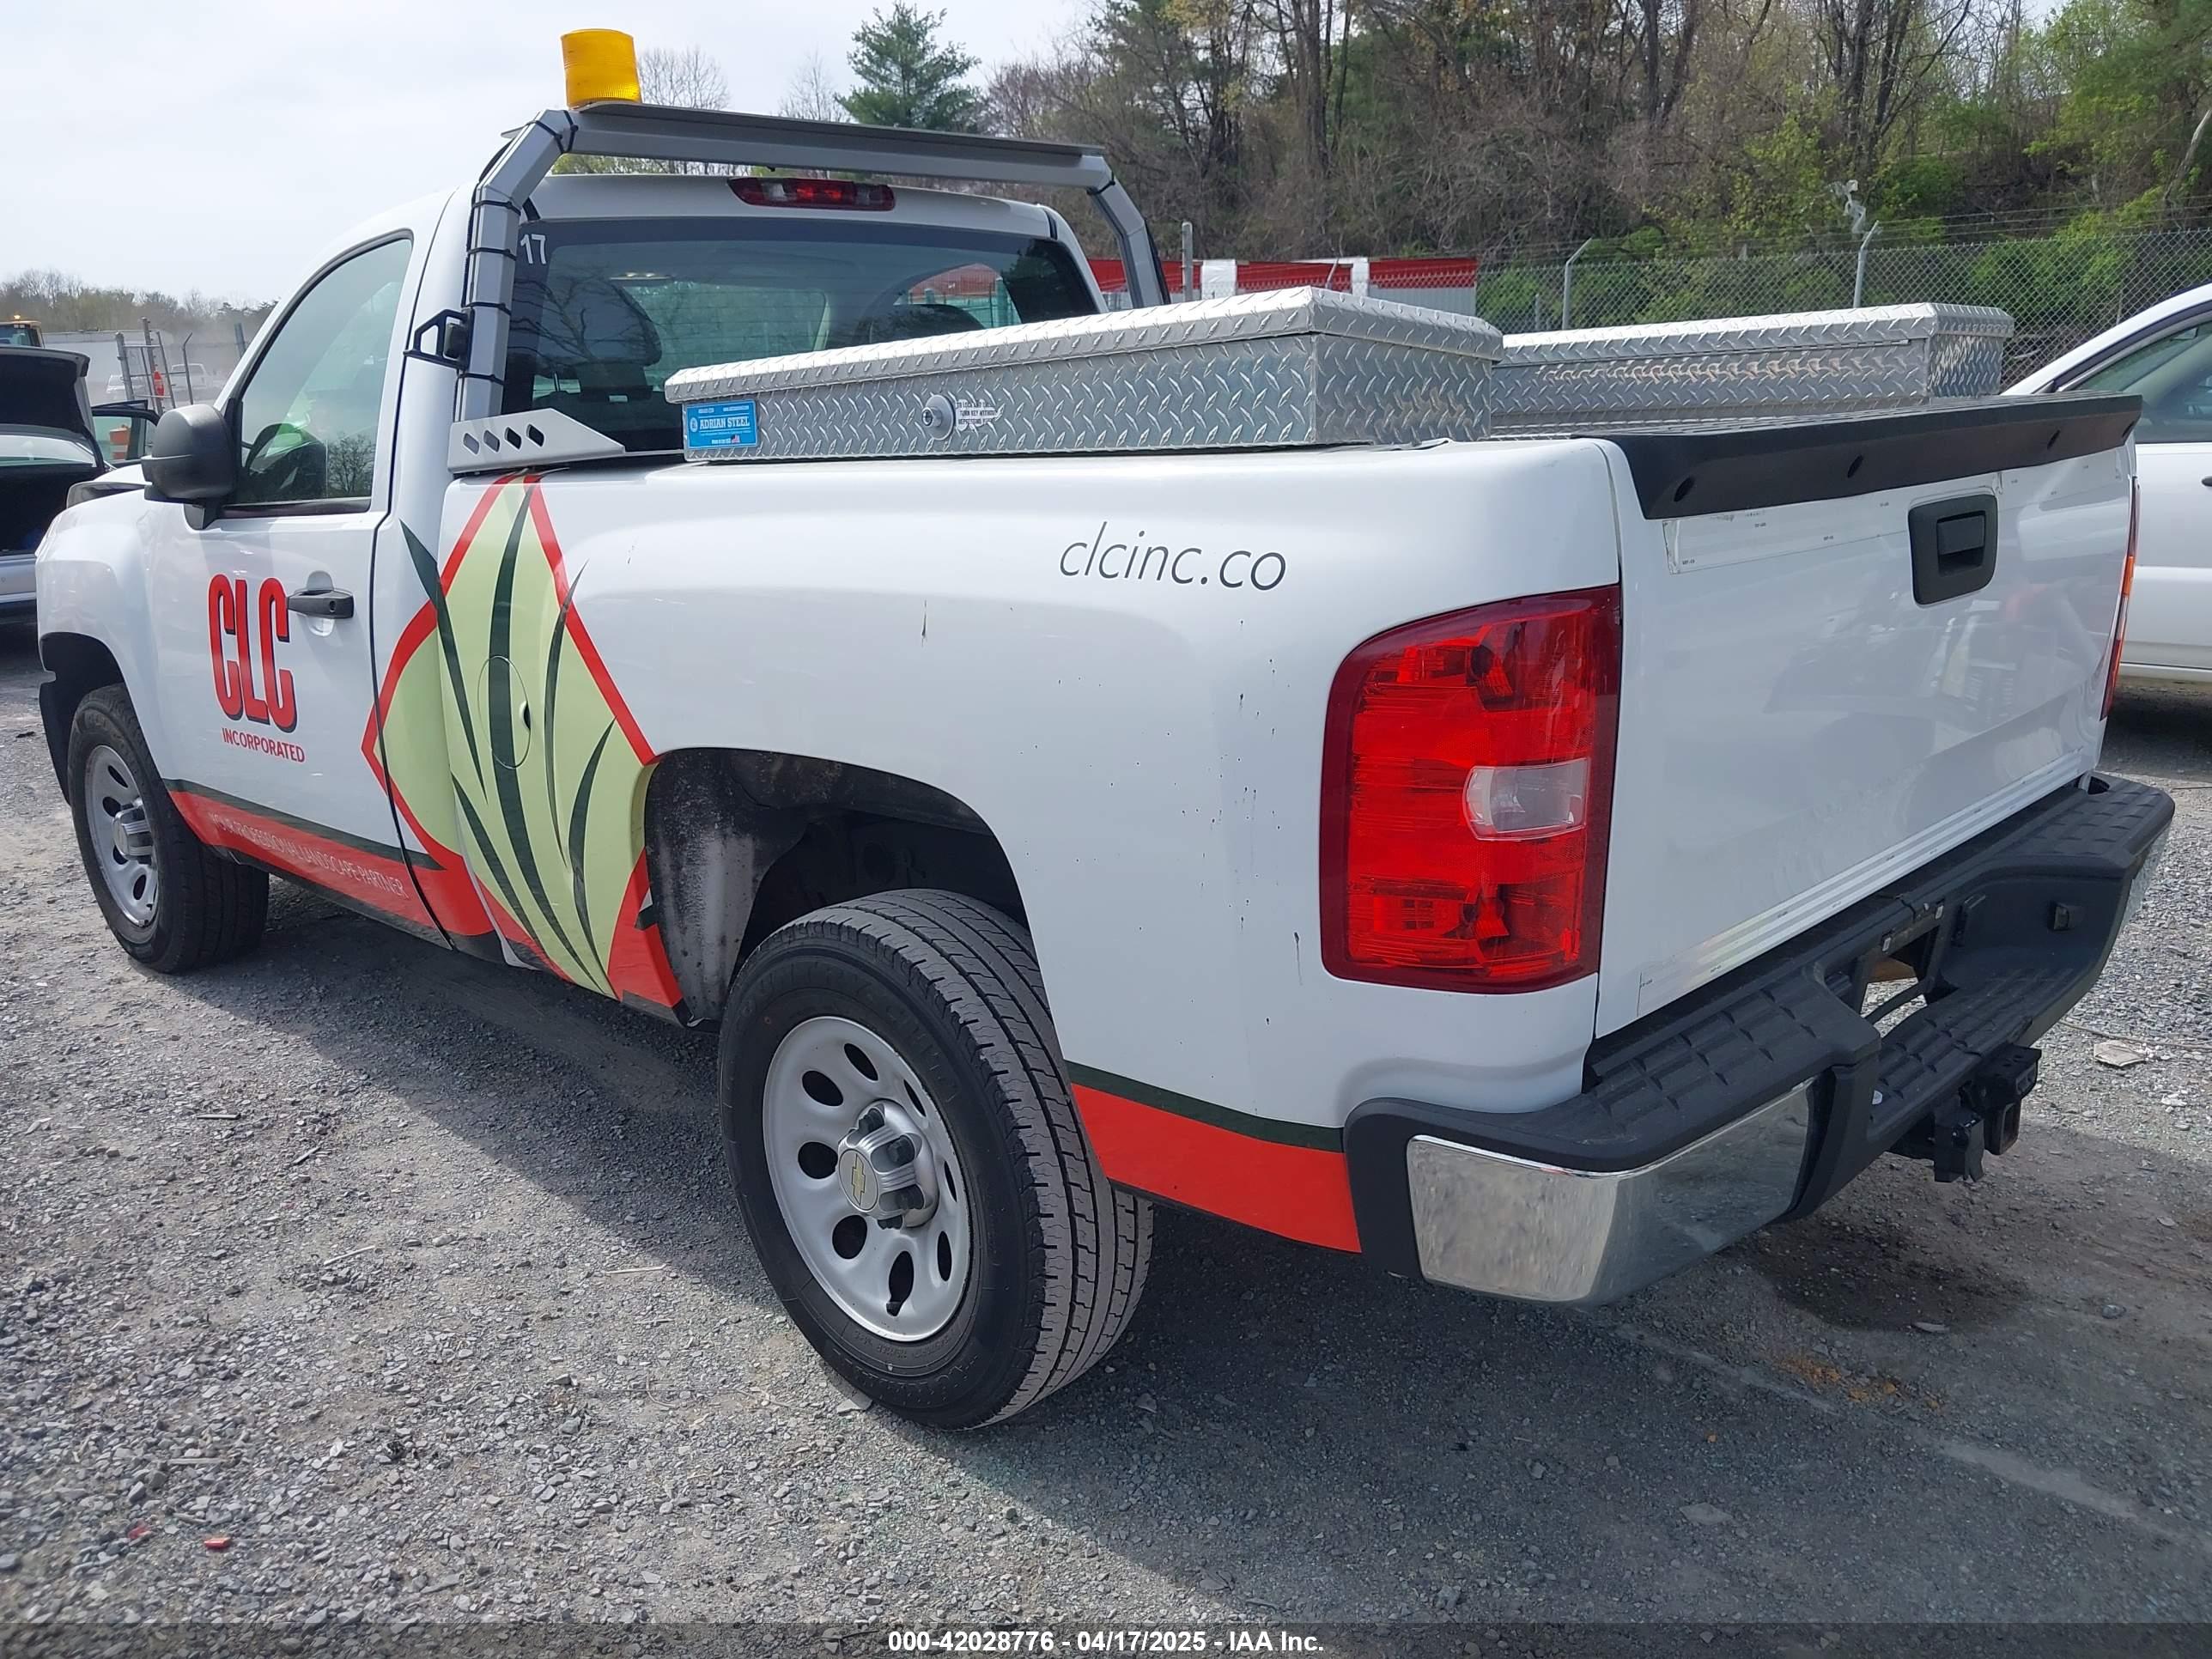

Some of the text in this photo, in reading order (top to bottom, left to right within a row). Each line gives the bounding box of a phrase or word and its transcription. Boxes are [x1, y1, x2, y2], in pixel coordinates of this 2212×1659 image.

[520, 234, 546, 264] 17
[699, 416, 750, 430] ADRIAN STEEL
[1059, 520, 1287, 591] clcinc.co
[208, 574, 298, 733] CLC
[222, 727, 306, 763] INCORPORATED
[298, 844, 361, 881] LANDSCAPE
[357, 864, 410, 899] PARTNER
